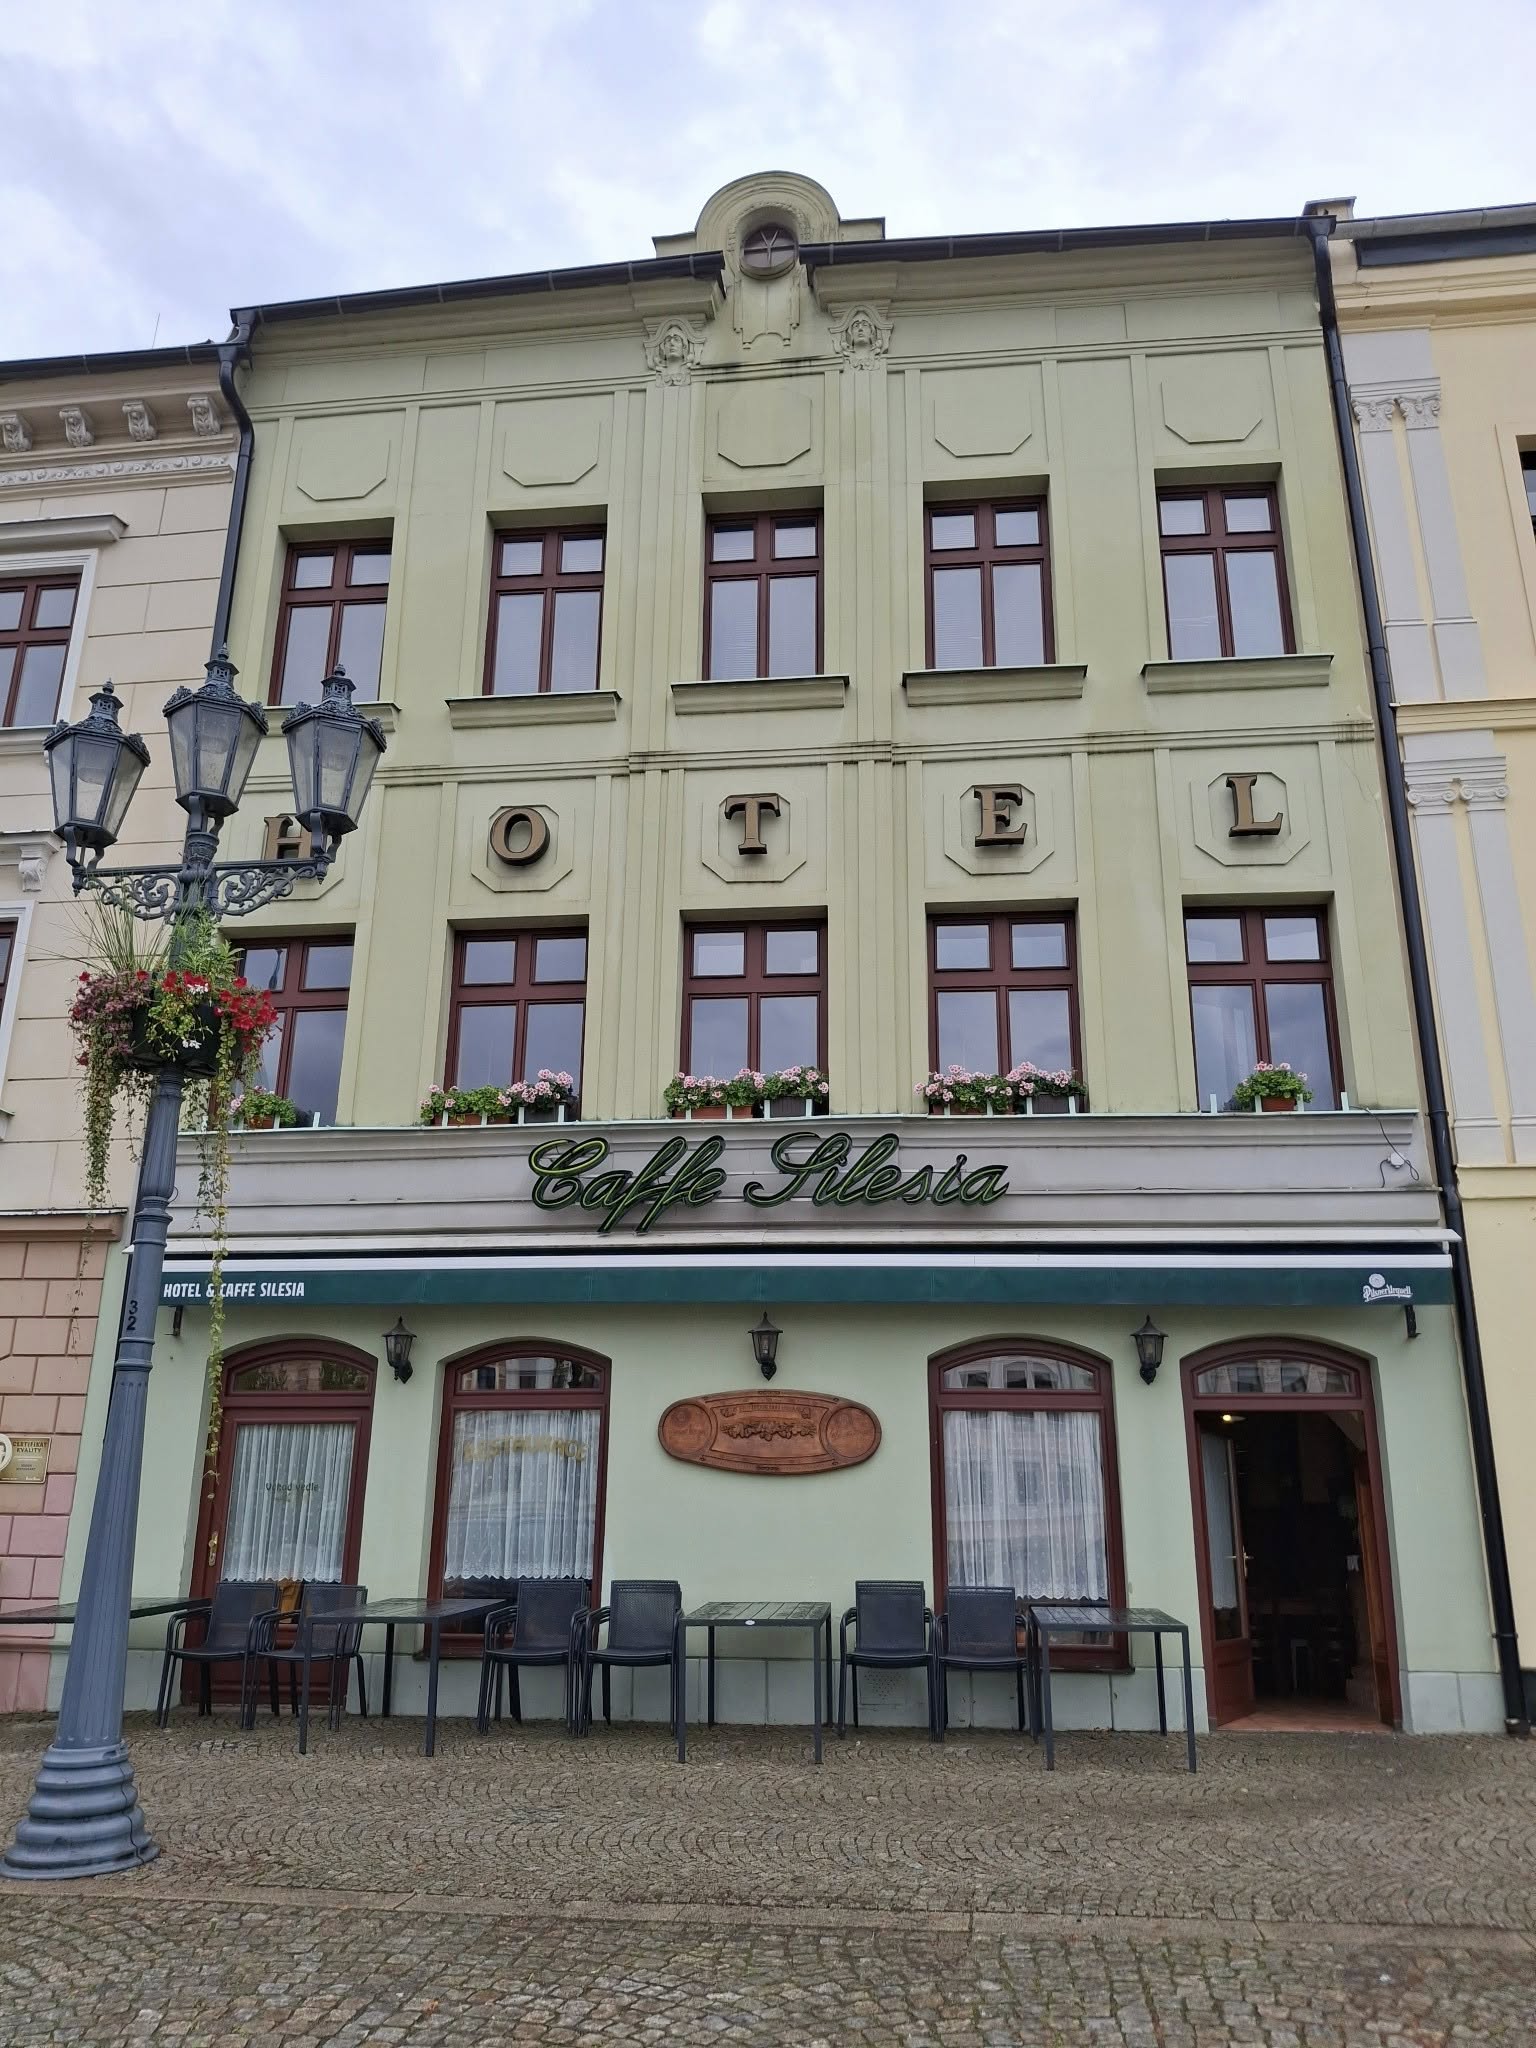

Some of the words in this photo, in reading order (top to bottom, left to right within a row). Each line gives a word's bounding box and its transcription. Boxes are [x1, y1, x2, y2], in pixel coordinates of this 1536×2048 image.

[527, 1134, 729, 1235] Caffe
[743, 1131, 1010, 1208] Silesia
[163, 1283, 201, 1298] HOTEL
[205, 1283, 216, 1298] &
[219, 1282, 256, 1297] CAFFE
[260, 1282, 305, 1297] SILESIA
[1362, 1285, 1388, 1302] Pilsner
[1386, 1284, 1413, 1298] Urquell
